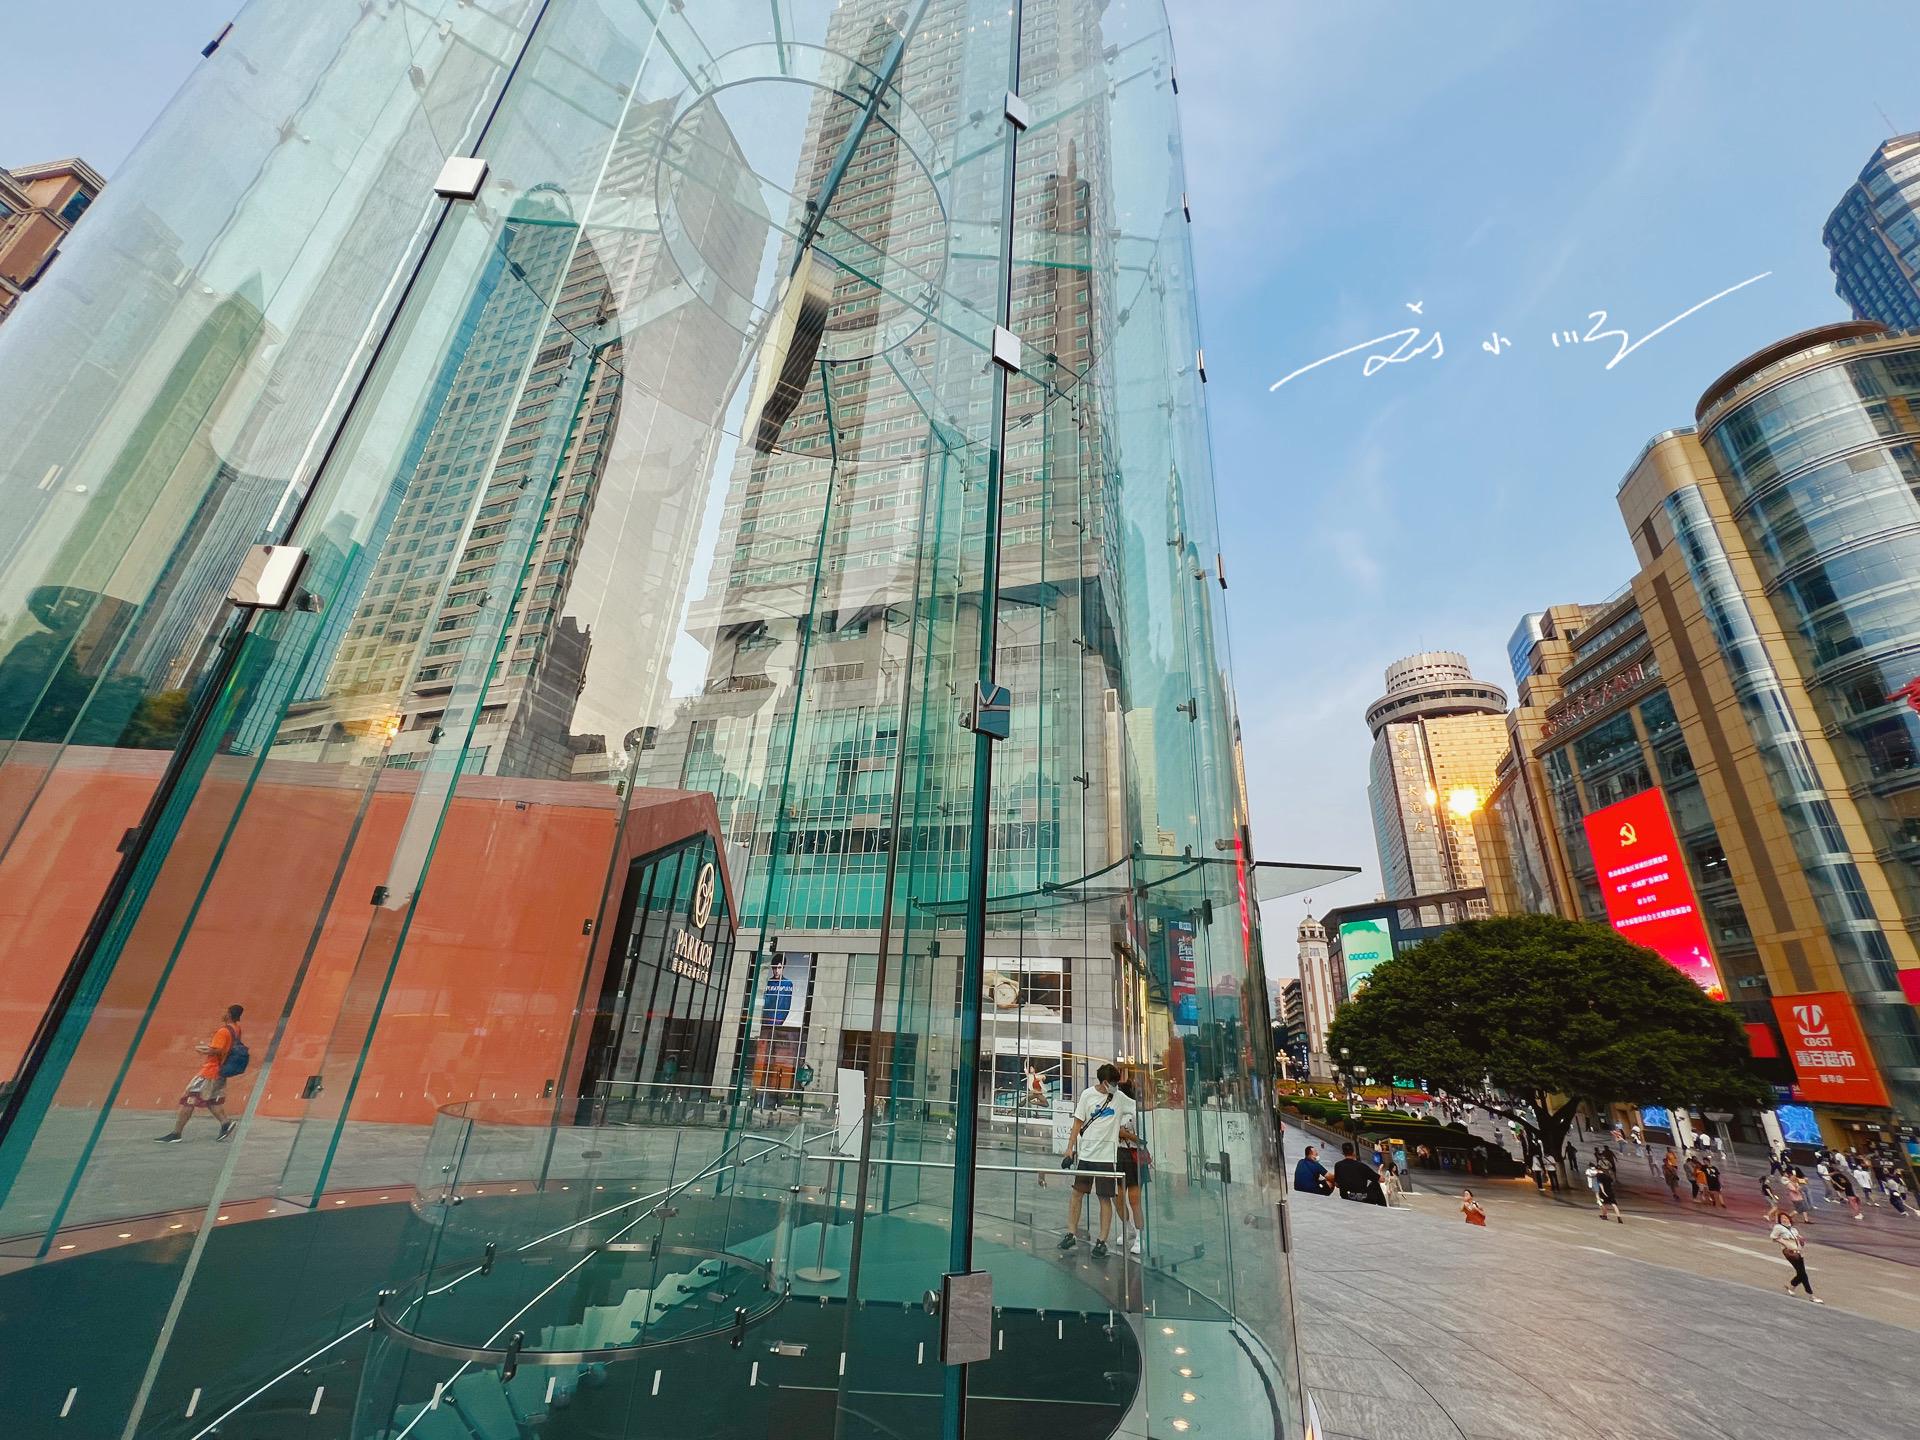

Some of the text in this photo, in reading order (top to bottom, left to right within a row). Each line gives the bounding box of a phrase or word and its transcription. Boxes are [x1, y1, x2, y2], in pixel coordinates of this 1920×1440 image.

[1803, 1037, 1833, 1047] CBEST
[1795, 1050, 1856, 1067] 重百超市
